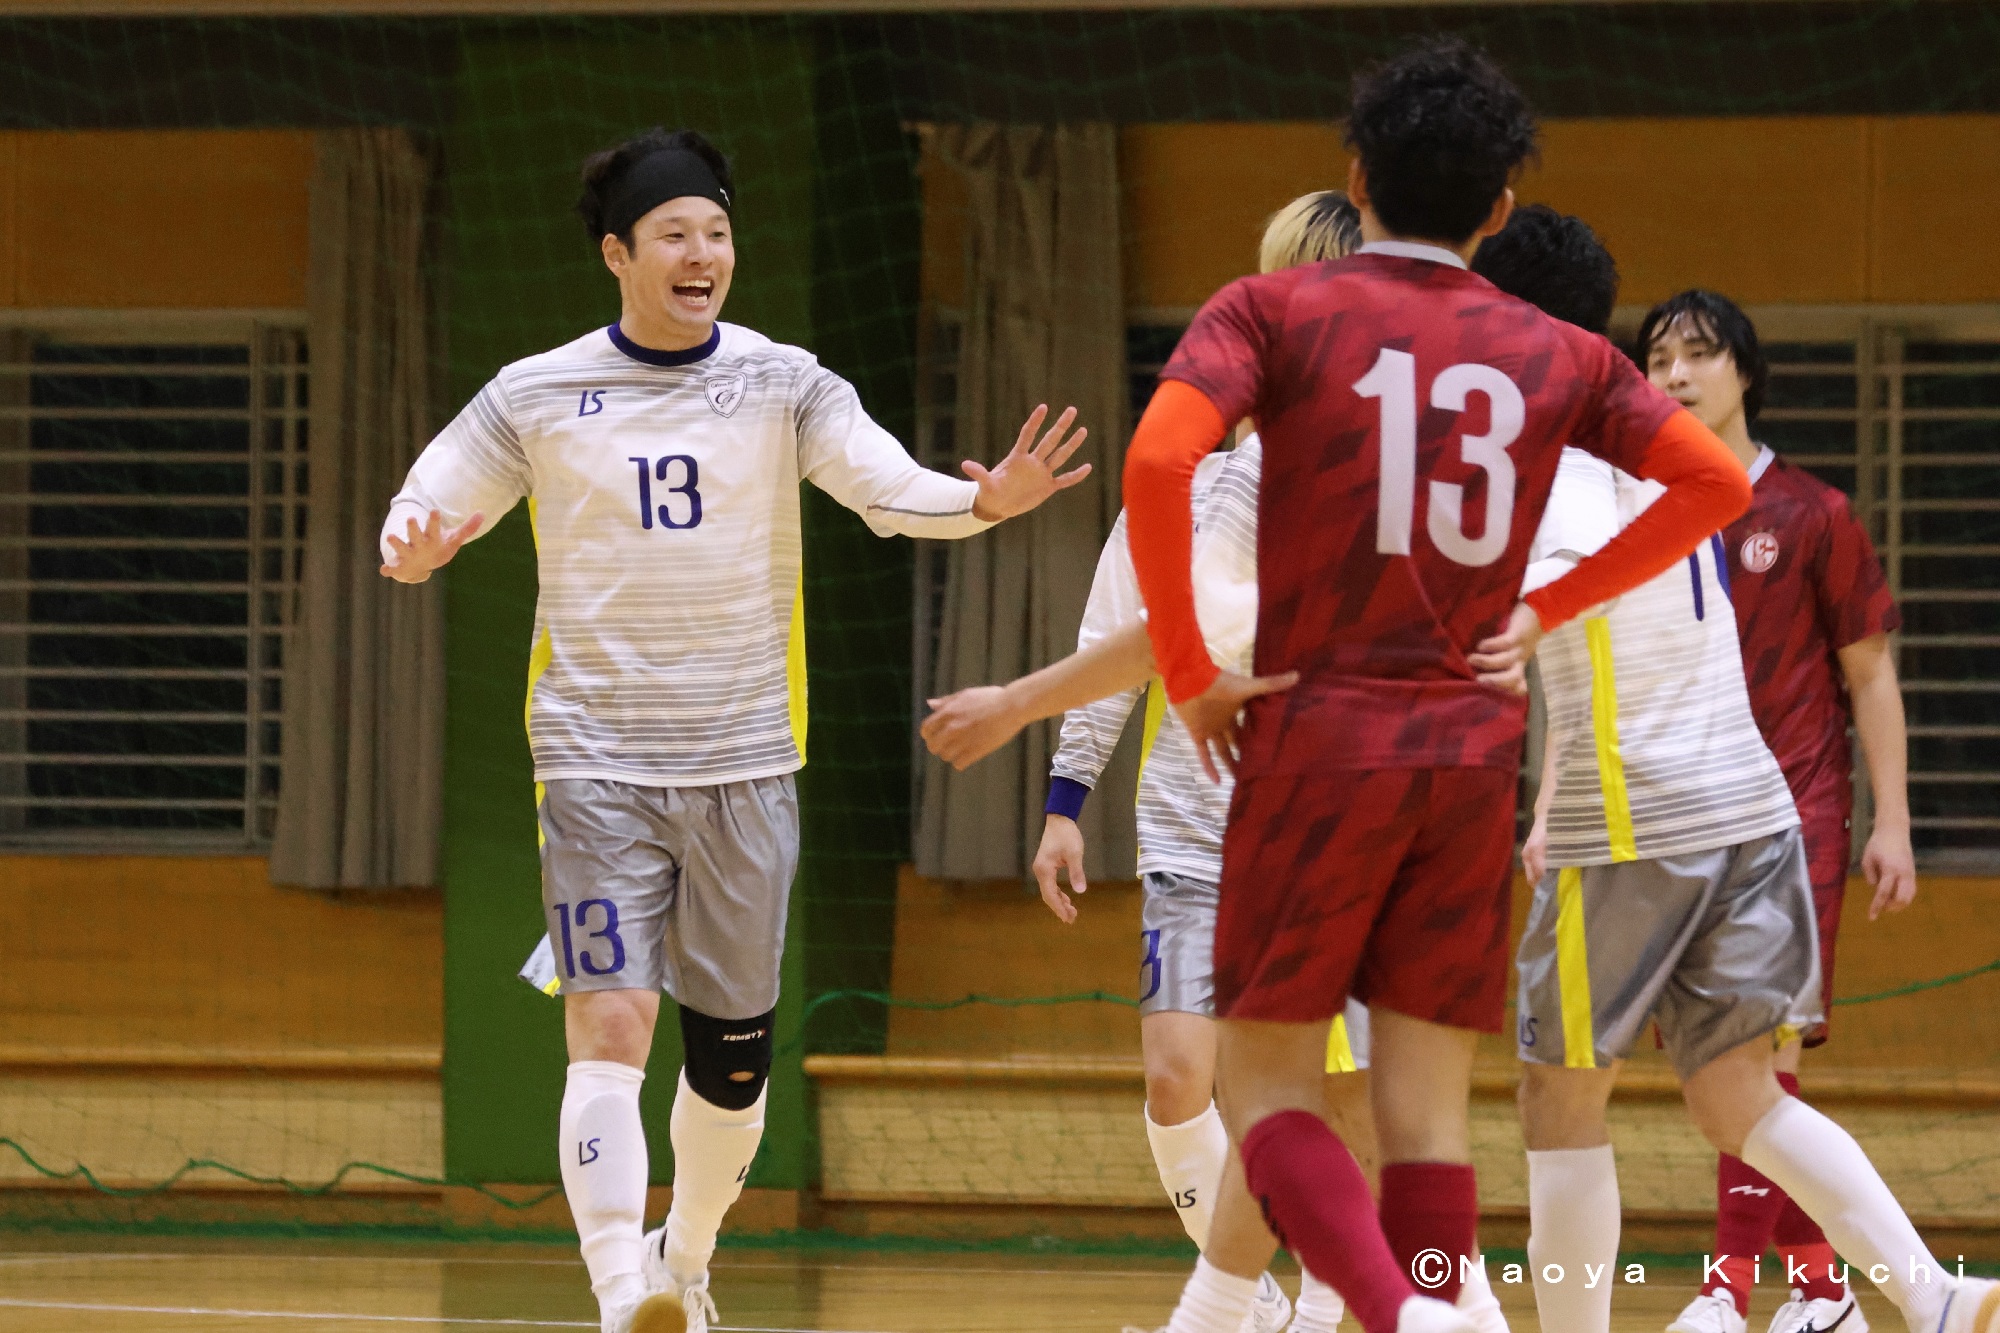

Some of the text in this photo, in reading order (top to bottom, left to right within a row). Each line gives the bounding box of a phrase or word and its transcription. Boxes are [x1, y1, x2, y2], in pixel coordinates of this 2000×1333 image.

[628, 454, 703, 530] 13
[1352, 347, 1526, 567] 13
[553, 898, 626, 979] 13
